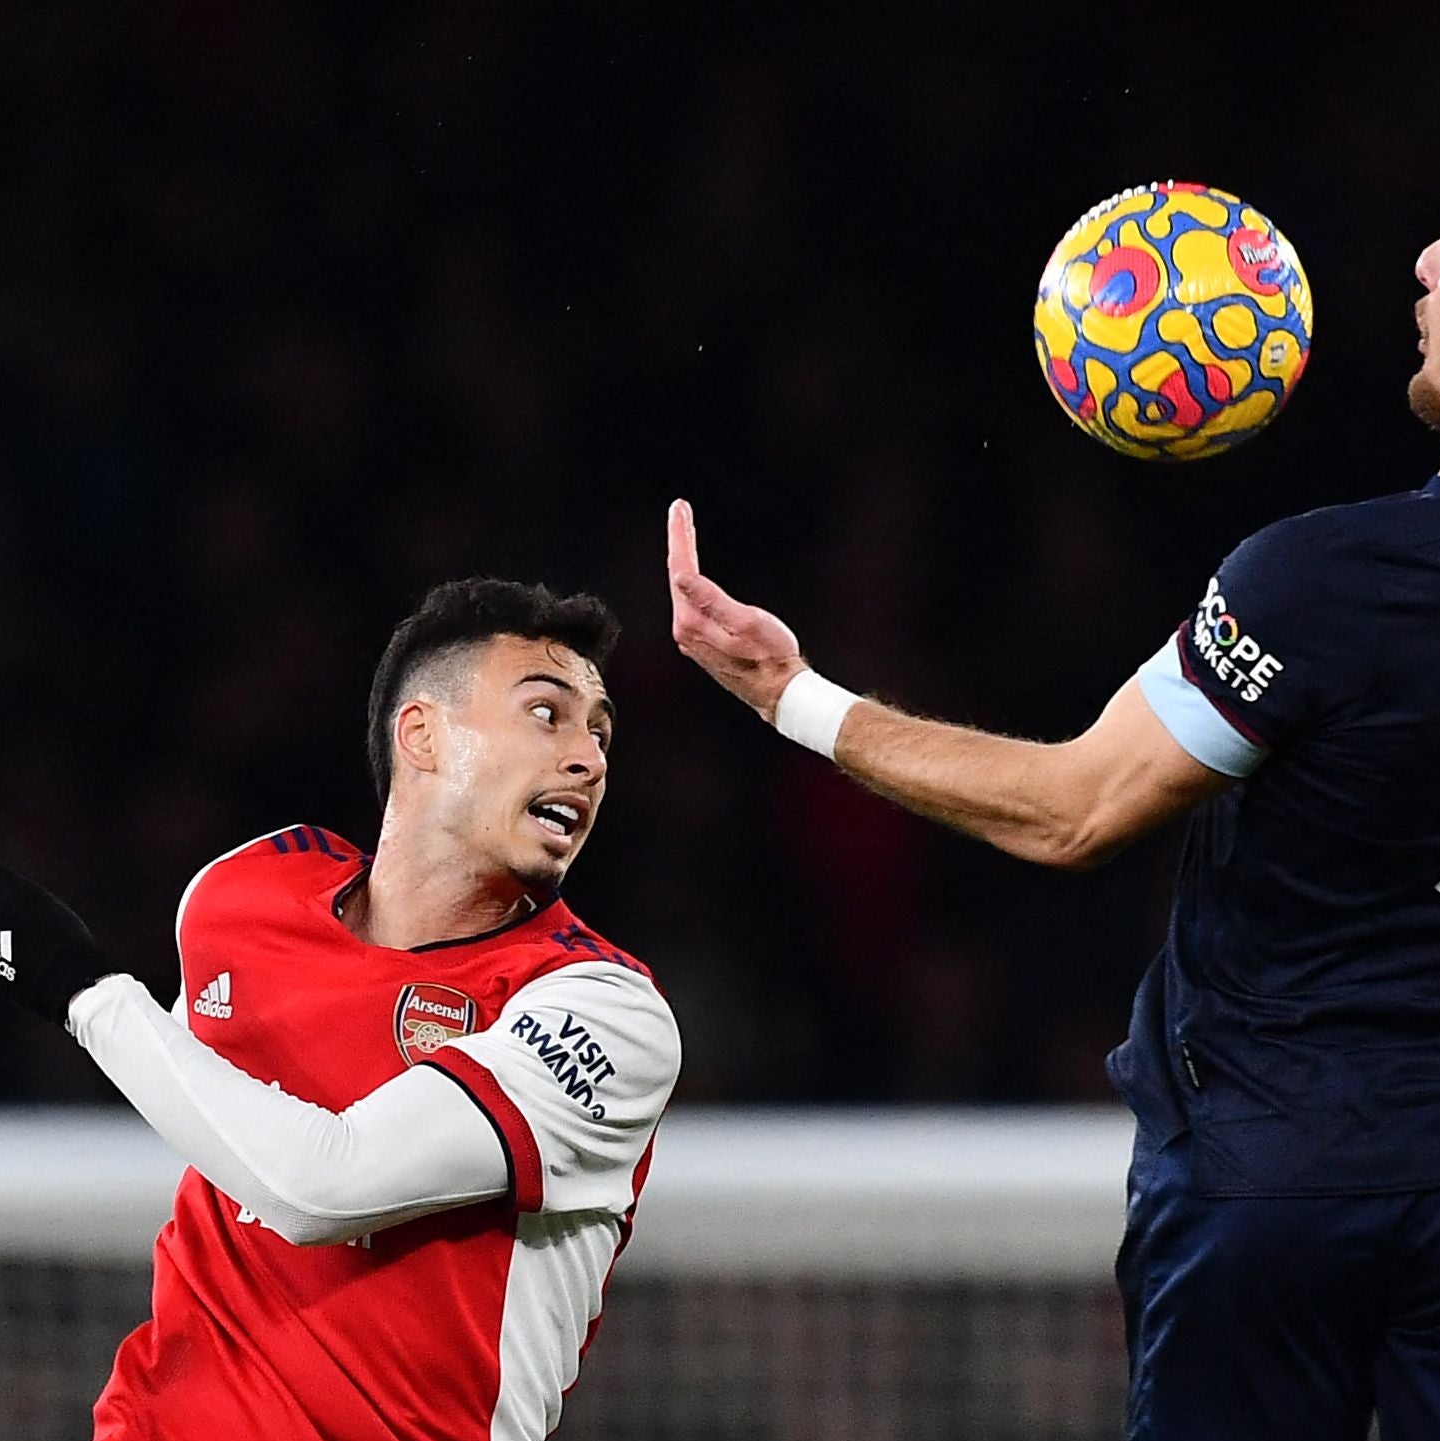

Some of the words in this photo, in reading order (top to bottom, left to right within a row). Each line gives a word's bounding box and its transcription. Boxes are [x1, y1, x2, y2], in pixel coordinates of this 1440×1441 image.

[193, 997, 233, 1020] adidas
[408, 994, 465, 1023] Arsenal
[559, 1012, 617, 1086] VISIT
